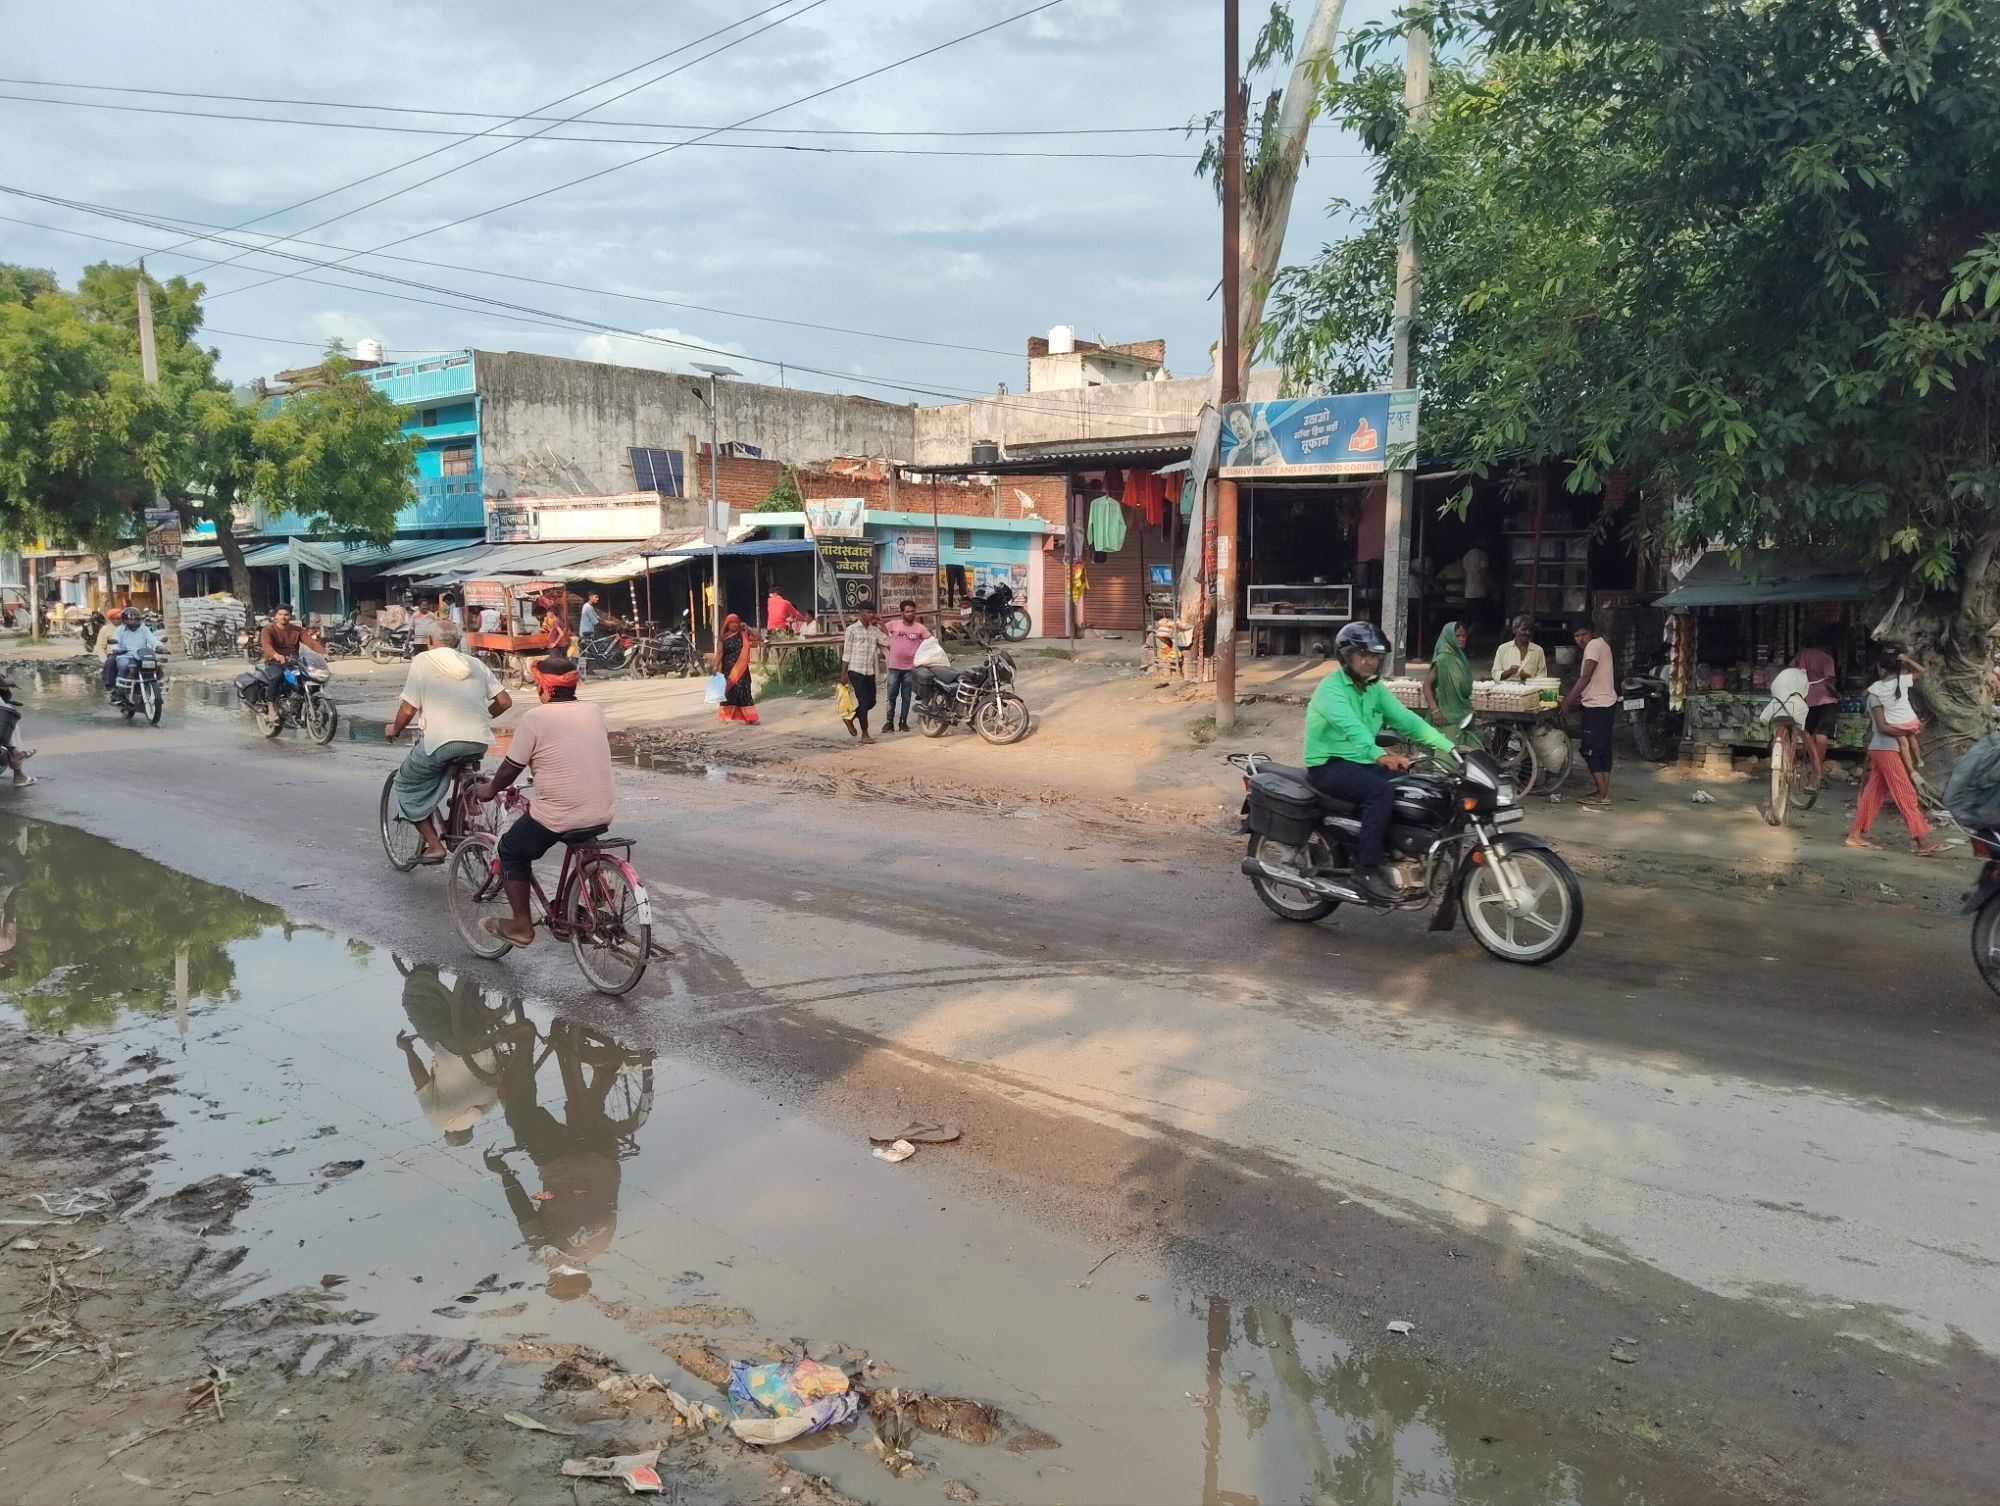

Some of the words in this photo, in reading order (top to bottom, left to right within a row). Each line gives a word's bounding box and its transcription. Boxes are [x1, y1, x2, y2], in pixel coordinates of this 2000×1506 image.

[1303, 408, 1331, 426] उठाओ
[1301, 435, 1329, 454] तूफान
[1226, 468, 1251, 476] SUNNY
[1252, 467, 1278, 475] SWEET
[1279, 466, 1296, 474] AND
[1298, 465, 1318, 473] FAST
[1319, 464, 1342, 472] FOOD
[1344, 462, 1377, 471] CORNER
[818, 545, 873, 557] जायसवाल
